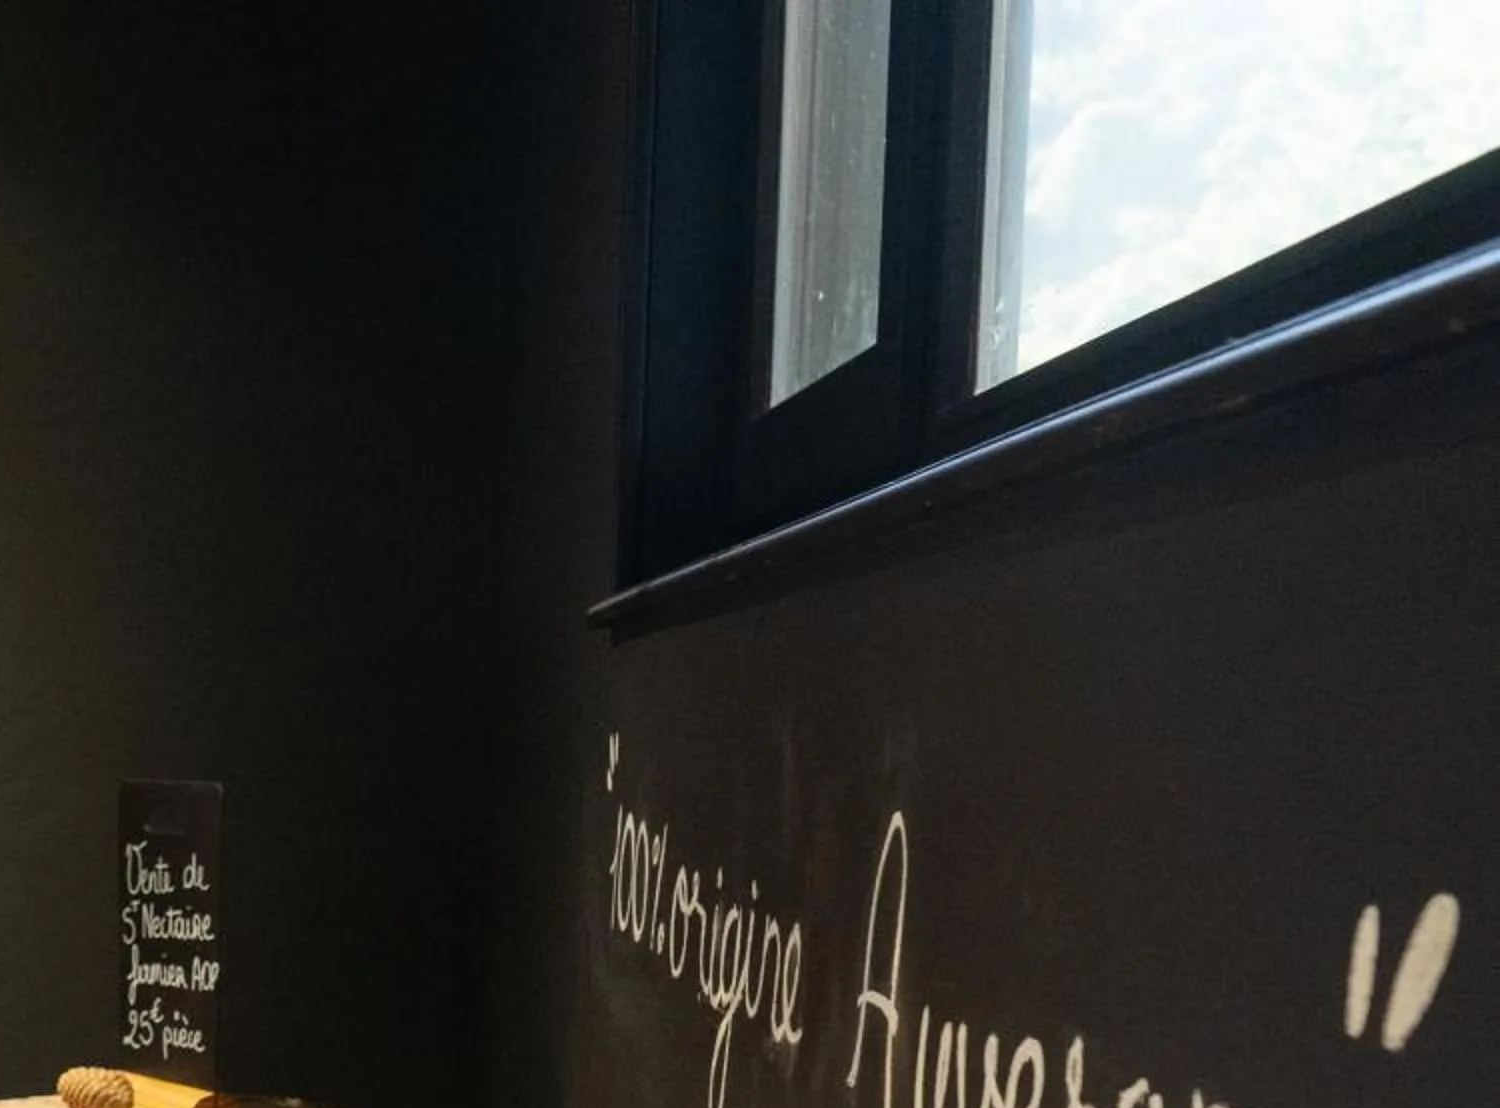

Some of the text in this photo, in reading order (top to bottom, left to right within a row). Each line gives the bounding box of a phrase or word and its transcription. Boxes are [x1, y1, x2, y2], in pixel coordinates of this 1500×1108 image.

[125, 840, 211, 895] Vente de
[609, 804, 669, 956] 100%
[141, 902, 216, 942] Nectaire
[161, 1010, 206, 1060] pièce
